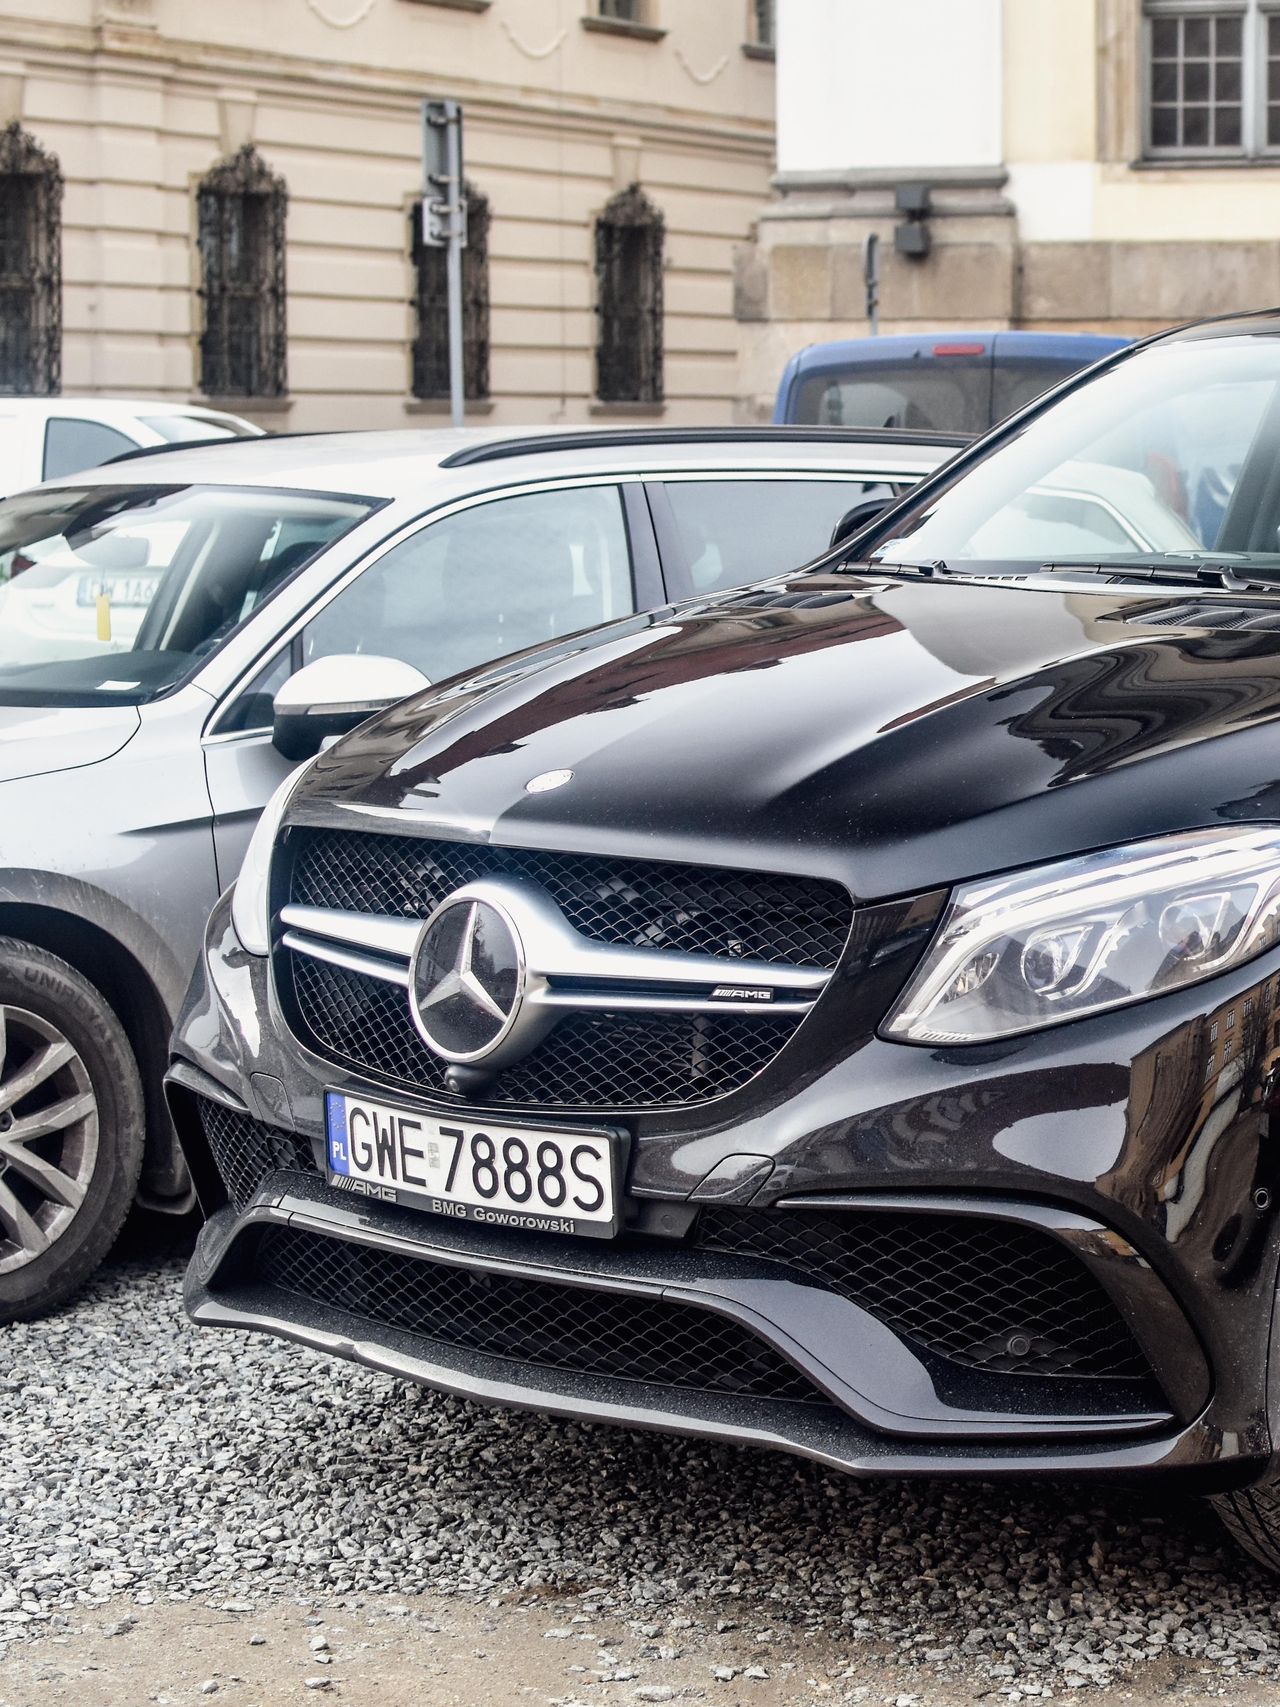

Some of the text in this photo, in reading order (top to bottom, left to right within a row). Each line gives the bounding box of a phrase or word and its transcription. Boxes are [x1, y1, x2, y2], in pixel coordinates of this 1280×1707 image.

[731, 989, 771, 1000] AMG
[332, 1140, 347, 1161] PL
[350, 1106, 604, 1212] GWE 7888S
[351, 1179, 397, 1202] AMG
[432, 1199, 576, 1234] BMG Goworowski
